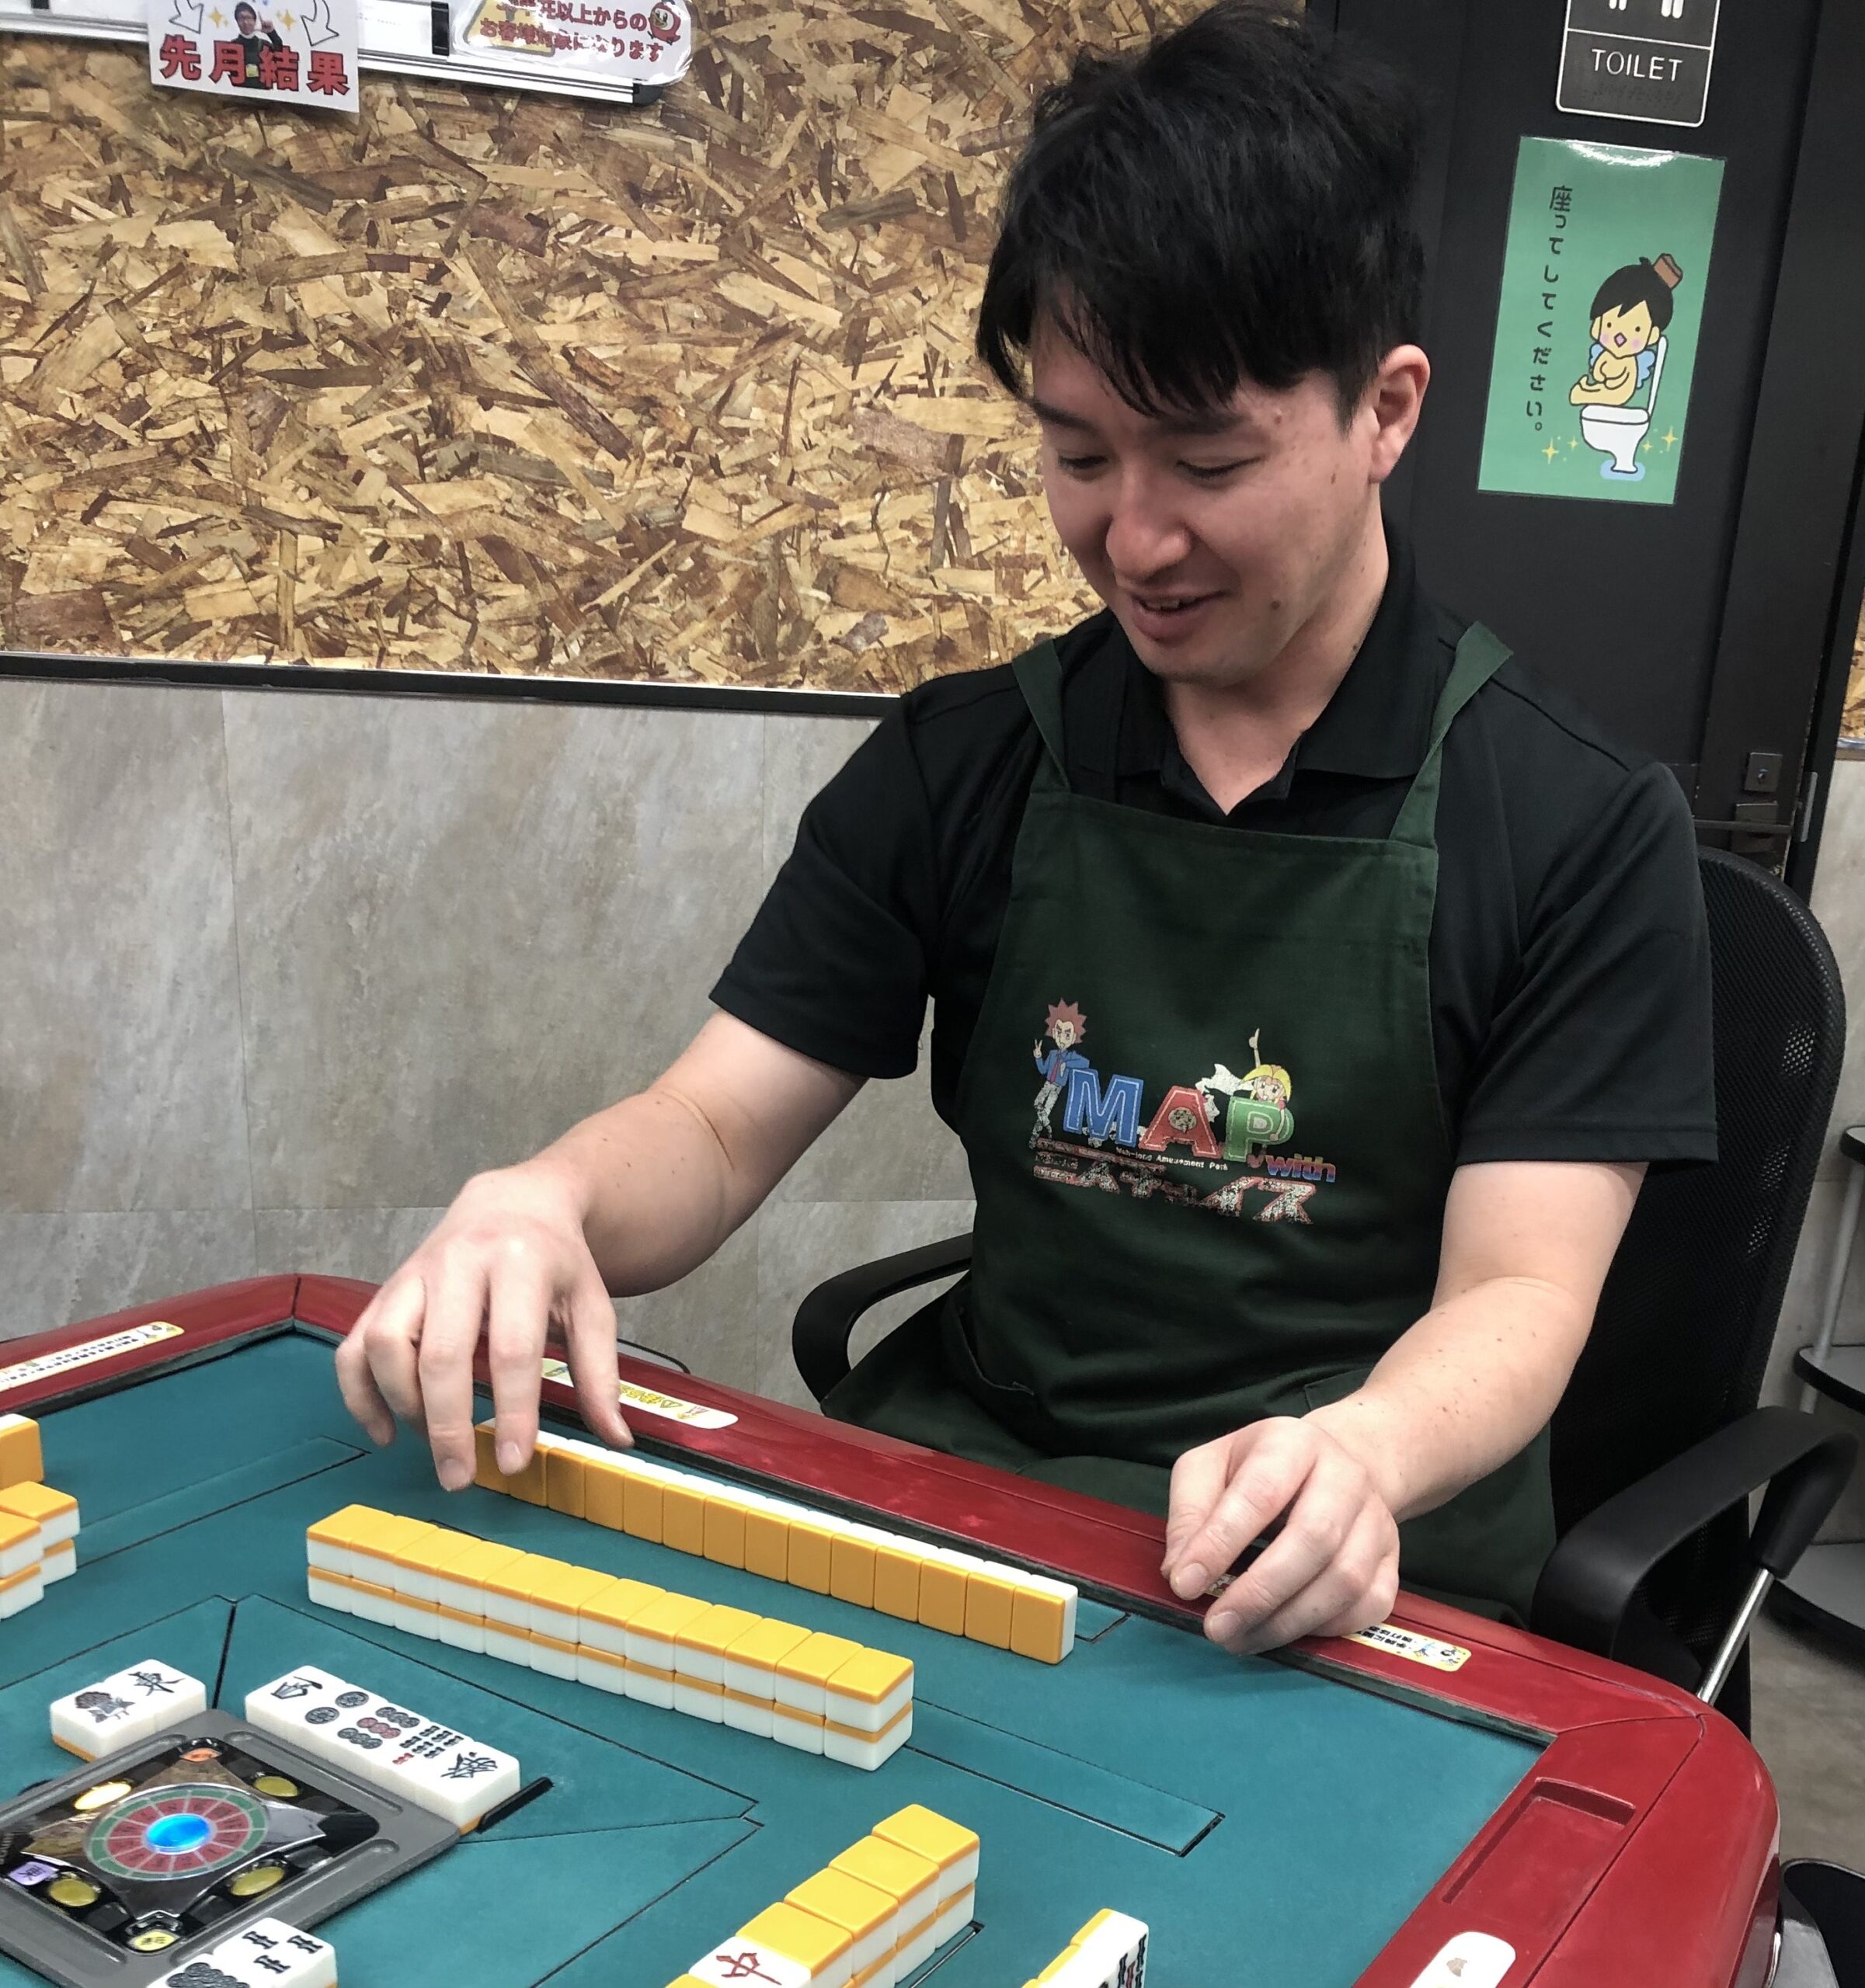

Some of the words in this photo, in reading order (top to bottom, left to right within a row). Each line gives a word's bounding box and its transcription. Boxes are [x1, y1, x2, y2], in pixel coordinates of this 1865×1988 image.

[159, 33, 351, 96] 先月結果
[1591, 48, 1683, 83] TOILET
[1526, 185, 1574, 431] 座ってしてください。
[1063, 1067, 1295, 1163] MAP
[1265, 1152, 1337, 1183] with
[715, 1952, 783, 1986] 中
